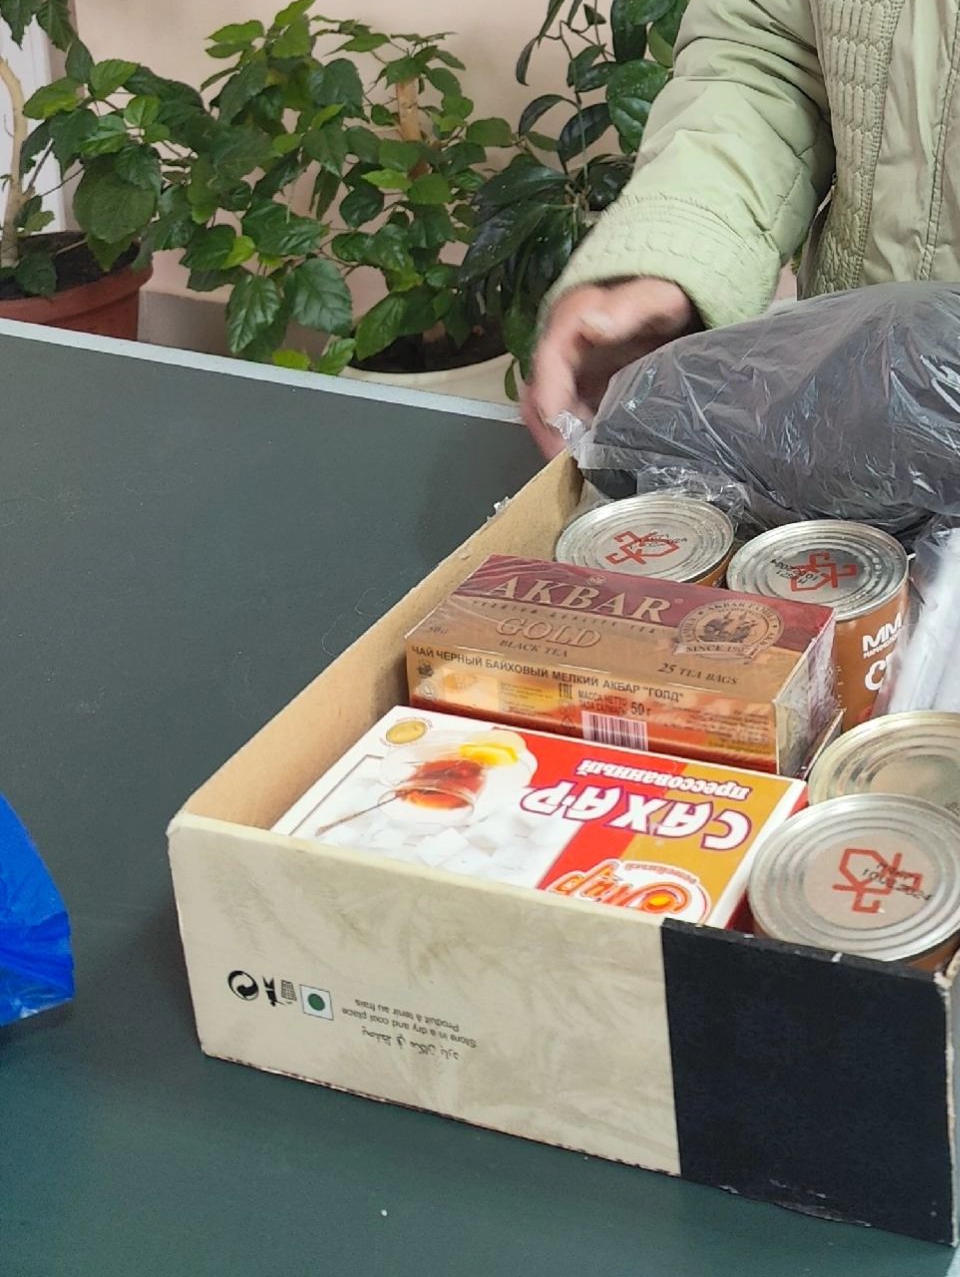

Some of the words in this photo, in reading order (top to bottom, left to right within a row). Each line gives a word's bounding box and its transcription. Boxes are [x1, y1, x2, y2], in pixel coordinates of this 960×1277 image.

[485, 575, 672, 624] AKBAR
[495, 617, 602, 649] GOLD
[499, 638, 541, 653] BLACK
[544, 646, 569, 659] TEA
[412, 645, 434, 659] ЧАЙ
[436, 650, 483, 667] ЧЕРНЫЙ
[485, 657, 549, 678] БАЙХОВЫЙ
[552, 669, 600, 687] МЕЛКИЙ
[603, 679, 640, 695] АКБАР
[657, 661, 677, 675] 25
[680, 667, 702, 679] TEA
[706, 672, 740, 686] BAGS
[630, 701, 645, 716] 50
[575, 758, 754, 802] прессованный
[519, 780, 753, 852] САХАР
[354, 998, 376, 1011] frais
[377, 1005, 391, 1014] au
[341, 1007, 367, 1021] place
[369, 1014, 390, 1028] cool
[392, 1019, 410, 1032] and
[412, 1023, 429, 1036] dry
[424, 1015, 460, 1033] Produit
[450, 1033, 477, 1049] Store
